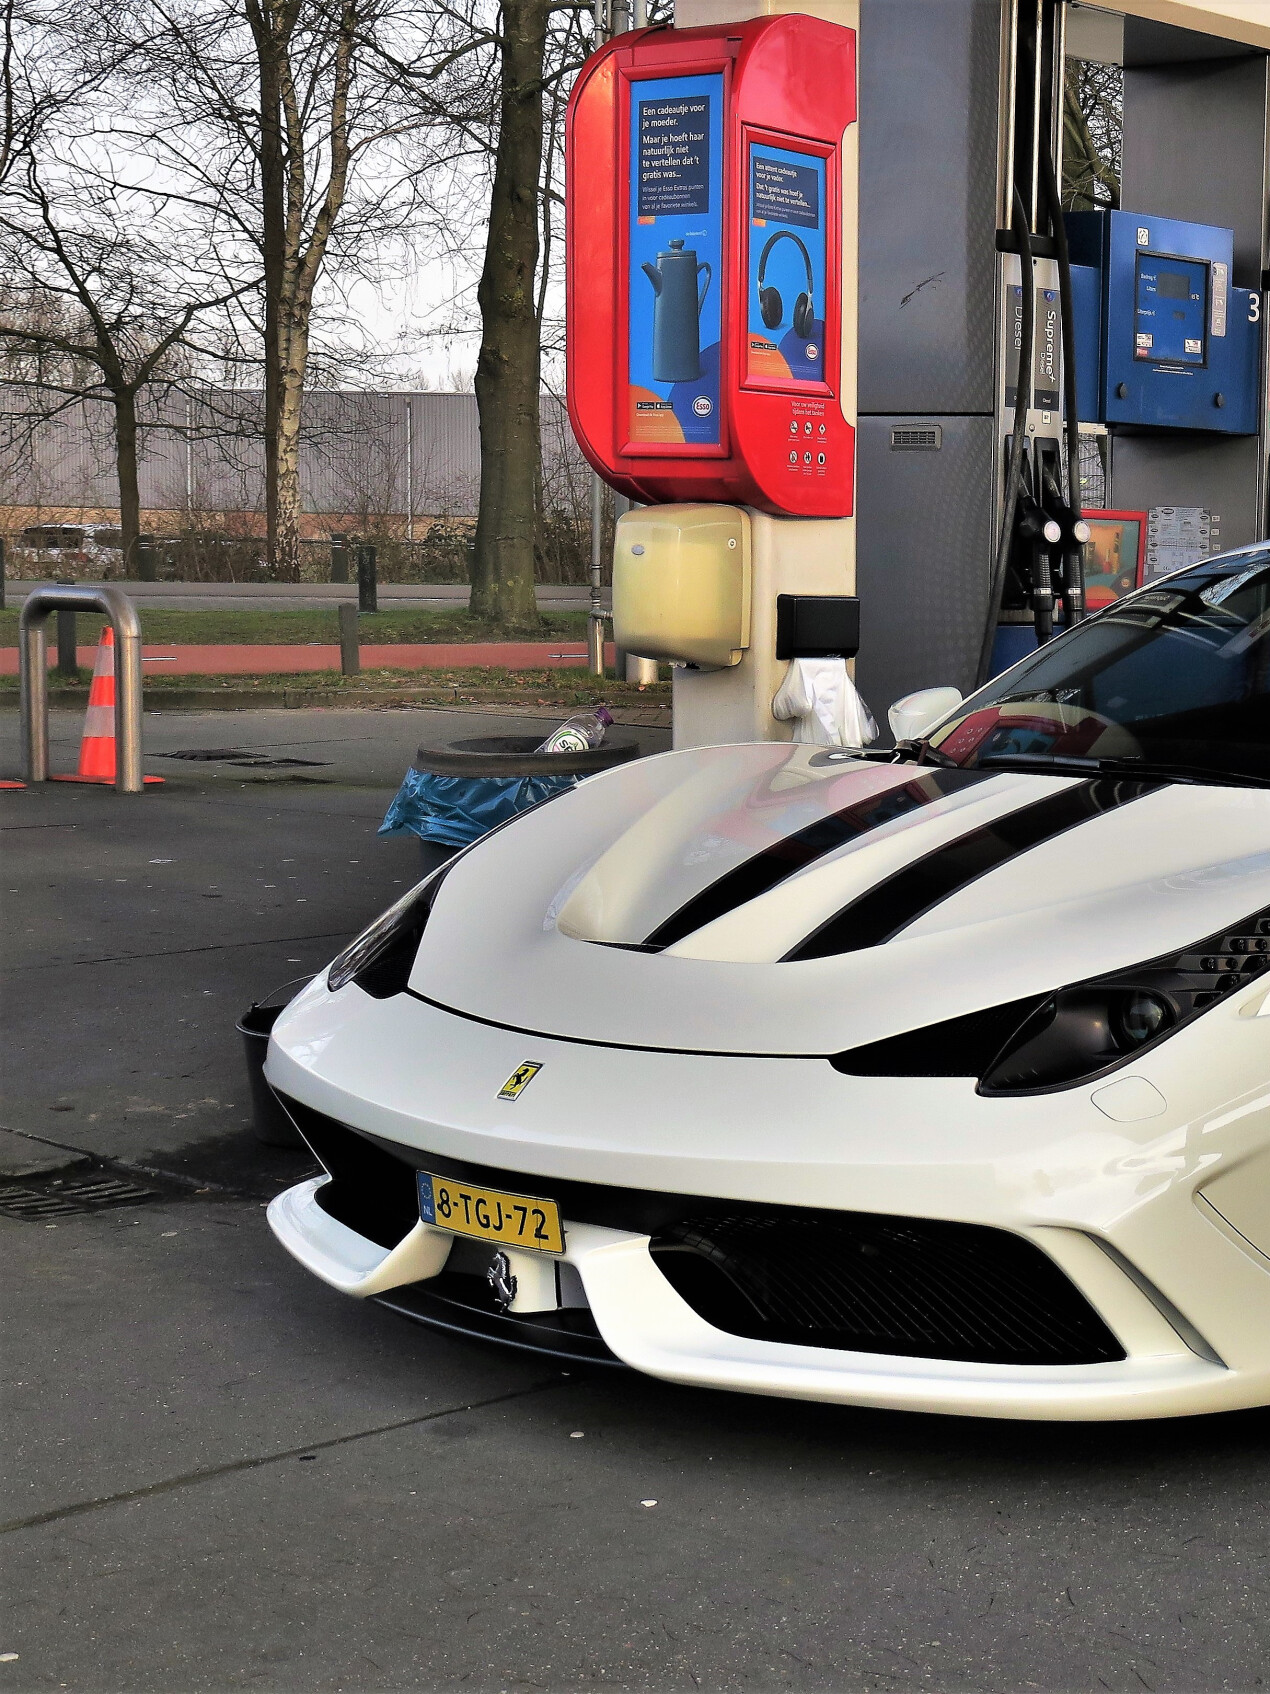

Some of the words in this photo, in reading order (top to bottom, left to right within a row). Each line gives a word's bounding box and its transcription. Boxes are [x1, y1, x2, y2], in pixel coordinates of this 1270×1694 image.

[643, 107, 655, 116] Een
[658, 104, 688, 115] cadeautje
[642, 119, 649, 130] je
[651, 117, 678, 127] moeder.
[643, 135, 660, 144] Maar
[661, 134, 669, 145] je
[670, 132, 688, 143] hoeft
[690, 132, 704, 141] haar
[643, 146, 674, 156] natuurlijk
[676, 145, 689, 153] niet
[651, 157, 680, 167] vertellen
[683, 156, 693, 165] dat
[756, 162, 764, 170] Een
[643, 170, 661, 181] gratis
[766, 173, 770, 181] je
[1248, 293, 1260, 322] 3
[1045, 310, 1057, 382] Supreme+
[696, 402, 709, 410] Esso
[423, 1206, 432, 1217] NL
[436, 1187, 549, 1240] 8-TGJ-72
